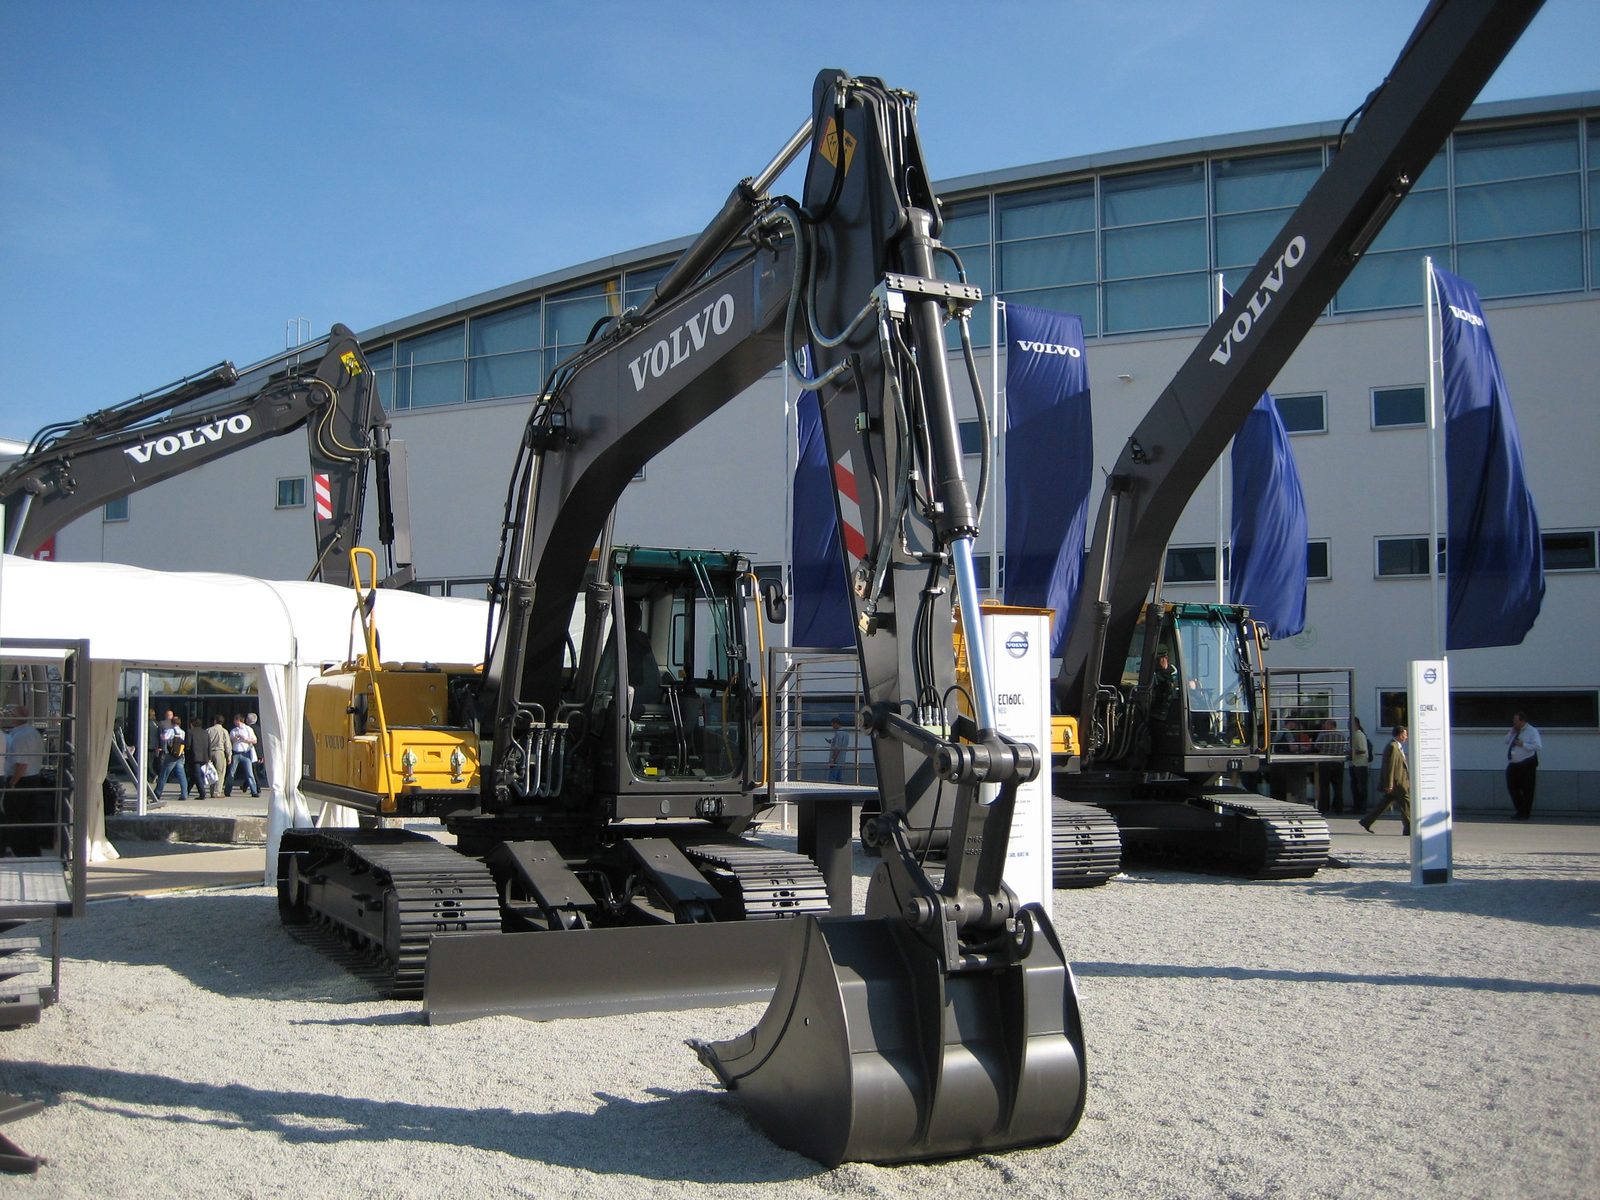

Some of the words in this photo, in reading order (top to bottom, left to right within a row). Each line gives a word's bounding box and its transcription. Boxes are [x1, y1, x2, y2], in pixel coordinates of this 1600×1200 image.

[1209, 235, 1306, 365] VOLVO
[628, 293, 735, 392] VOLVO
[1017, 340, 1081, 358] VOLVO
[123, 414, 252, 463] VOLVO
[325, 735, 345, 750] VOLVO
